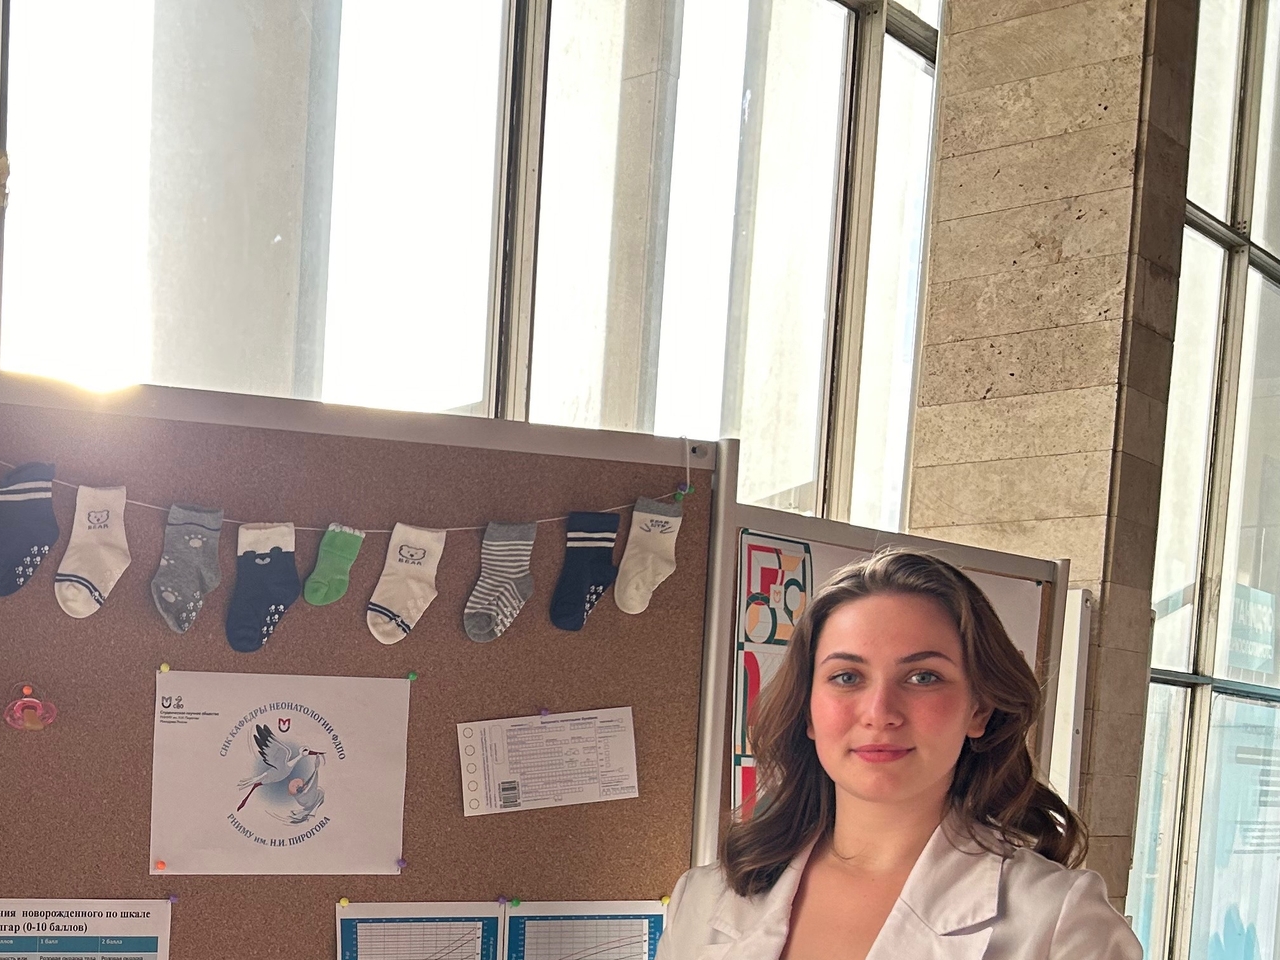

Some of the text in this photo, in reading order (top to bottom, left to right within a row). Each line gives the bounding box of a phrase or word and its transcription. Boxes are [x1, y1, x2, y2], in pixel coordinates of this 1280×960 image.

[398, 558, 422, 566] BEAR
[219, 702, 346, 760] СНК КАФЕДРЫ НЕОНАТОЛОГИИ ФДПО
[226, 813, 255, 840] РНИМУ
[270, 836, 287, 847] Н.И.
[289, 815, 332, 847] ПИРОГОВА
[22, 909, 103, 919] новорожденного
[120, 908, 151, 919] шкале
[23, 921, 47, 934] (0-10
[49, 921, 88, 933] баллов)
